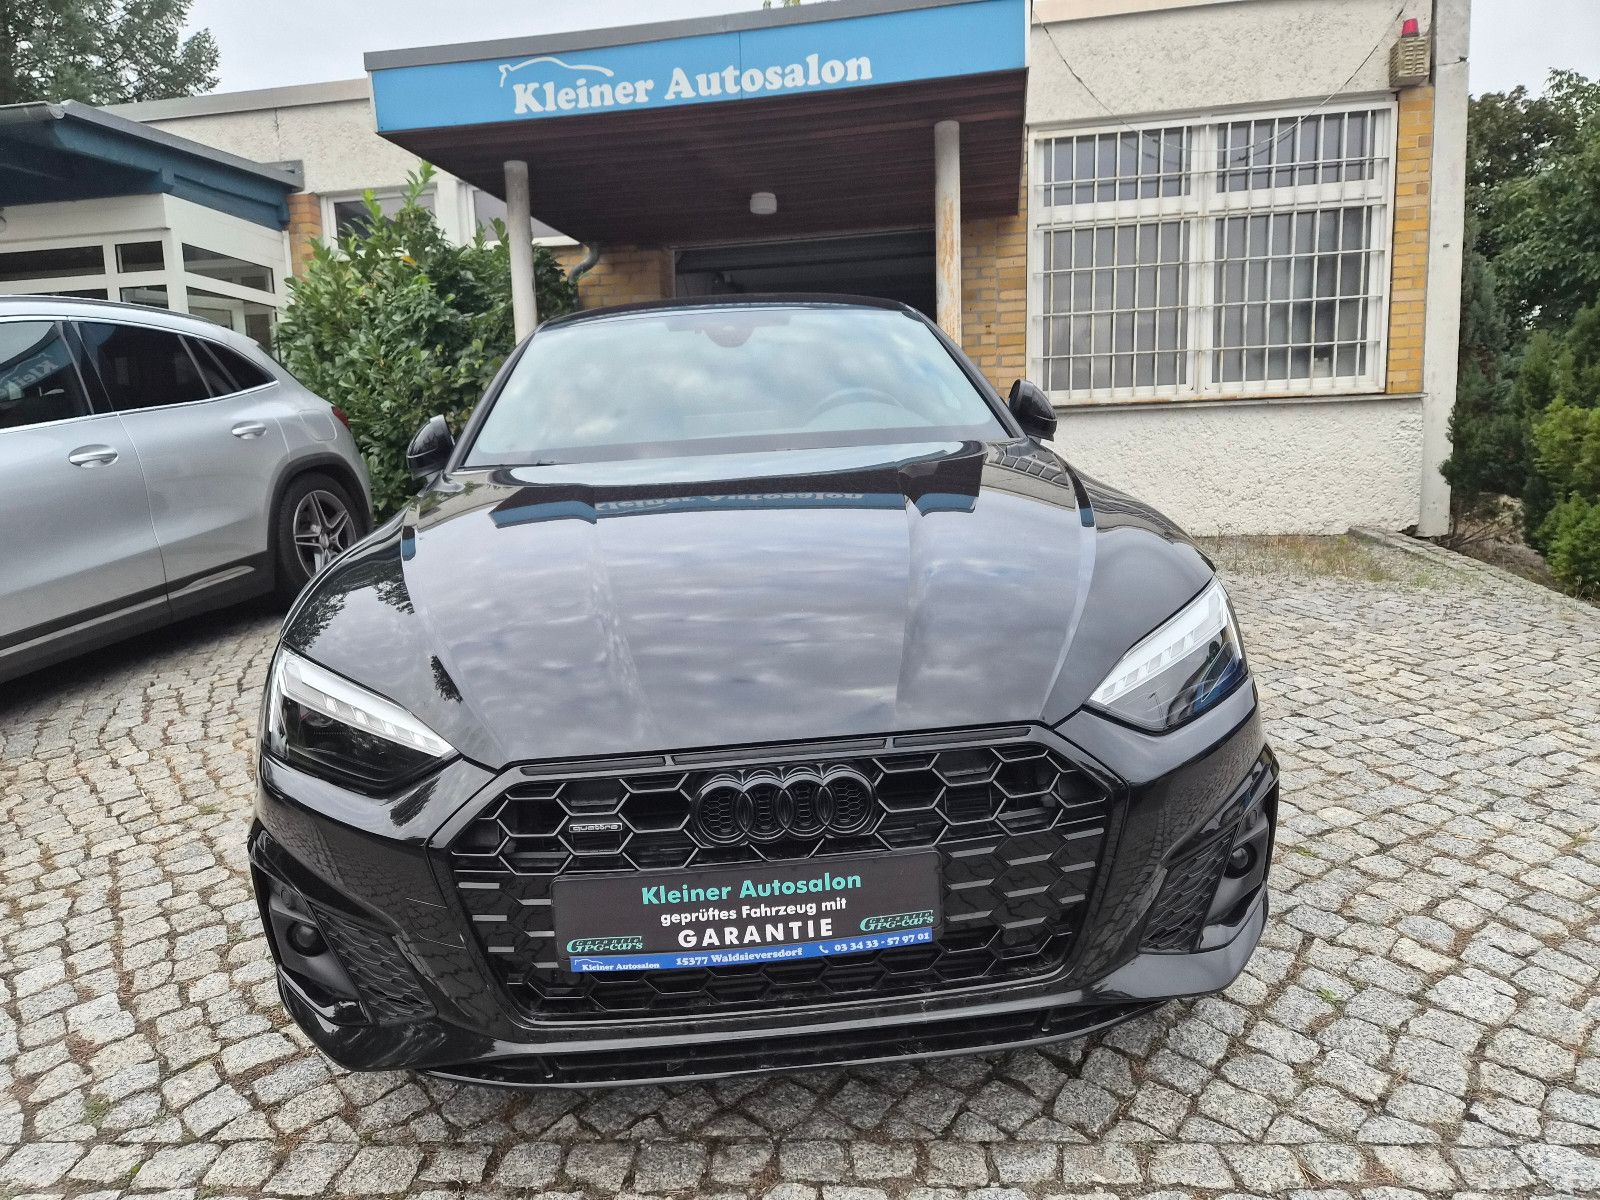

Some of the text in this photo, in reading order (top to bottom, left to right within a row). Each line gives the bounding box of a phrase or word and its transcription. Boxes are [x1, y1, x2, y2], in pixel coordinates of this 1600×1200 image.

[513, 53, 873, 114] Kleiner Autosalon
[573, 824, 618, 832] quattro
[641, 872, 861, 905] Kleiner Autosalon
[660, 897, 847, 927] geprüftes Fahrzeug mit
[677, 918, 833, 948] GARANTIE
[834, 943, 848, 952] 03
[850, 941, 864, 951] 34
[865, 939, 879, 949] 33
[886, 937, 900, 946] 57
[902, 934, 916, 943] 97
[917, 932, 930, 940] 01
[582, 962, 660, 971] Kleiner Autosalon
[675, 947, 803, 966] 15377 Waldsieversdorf
